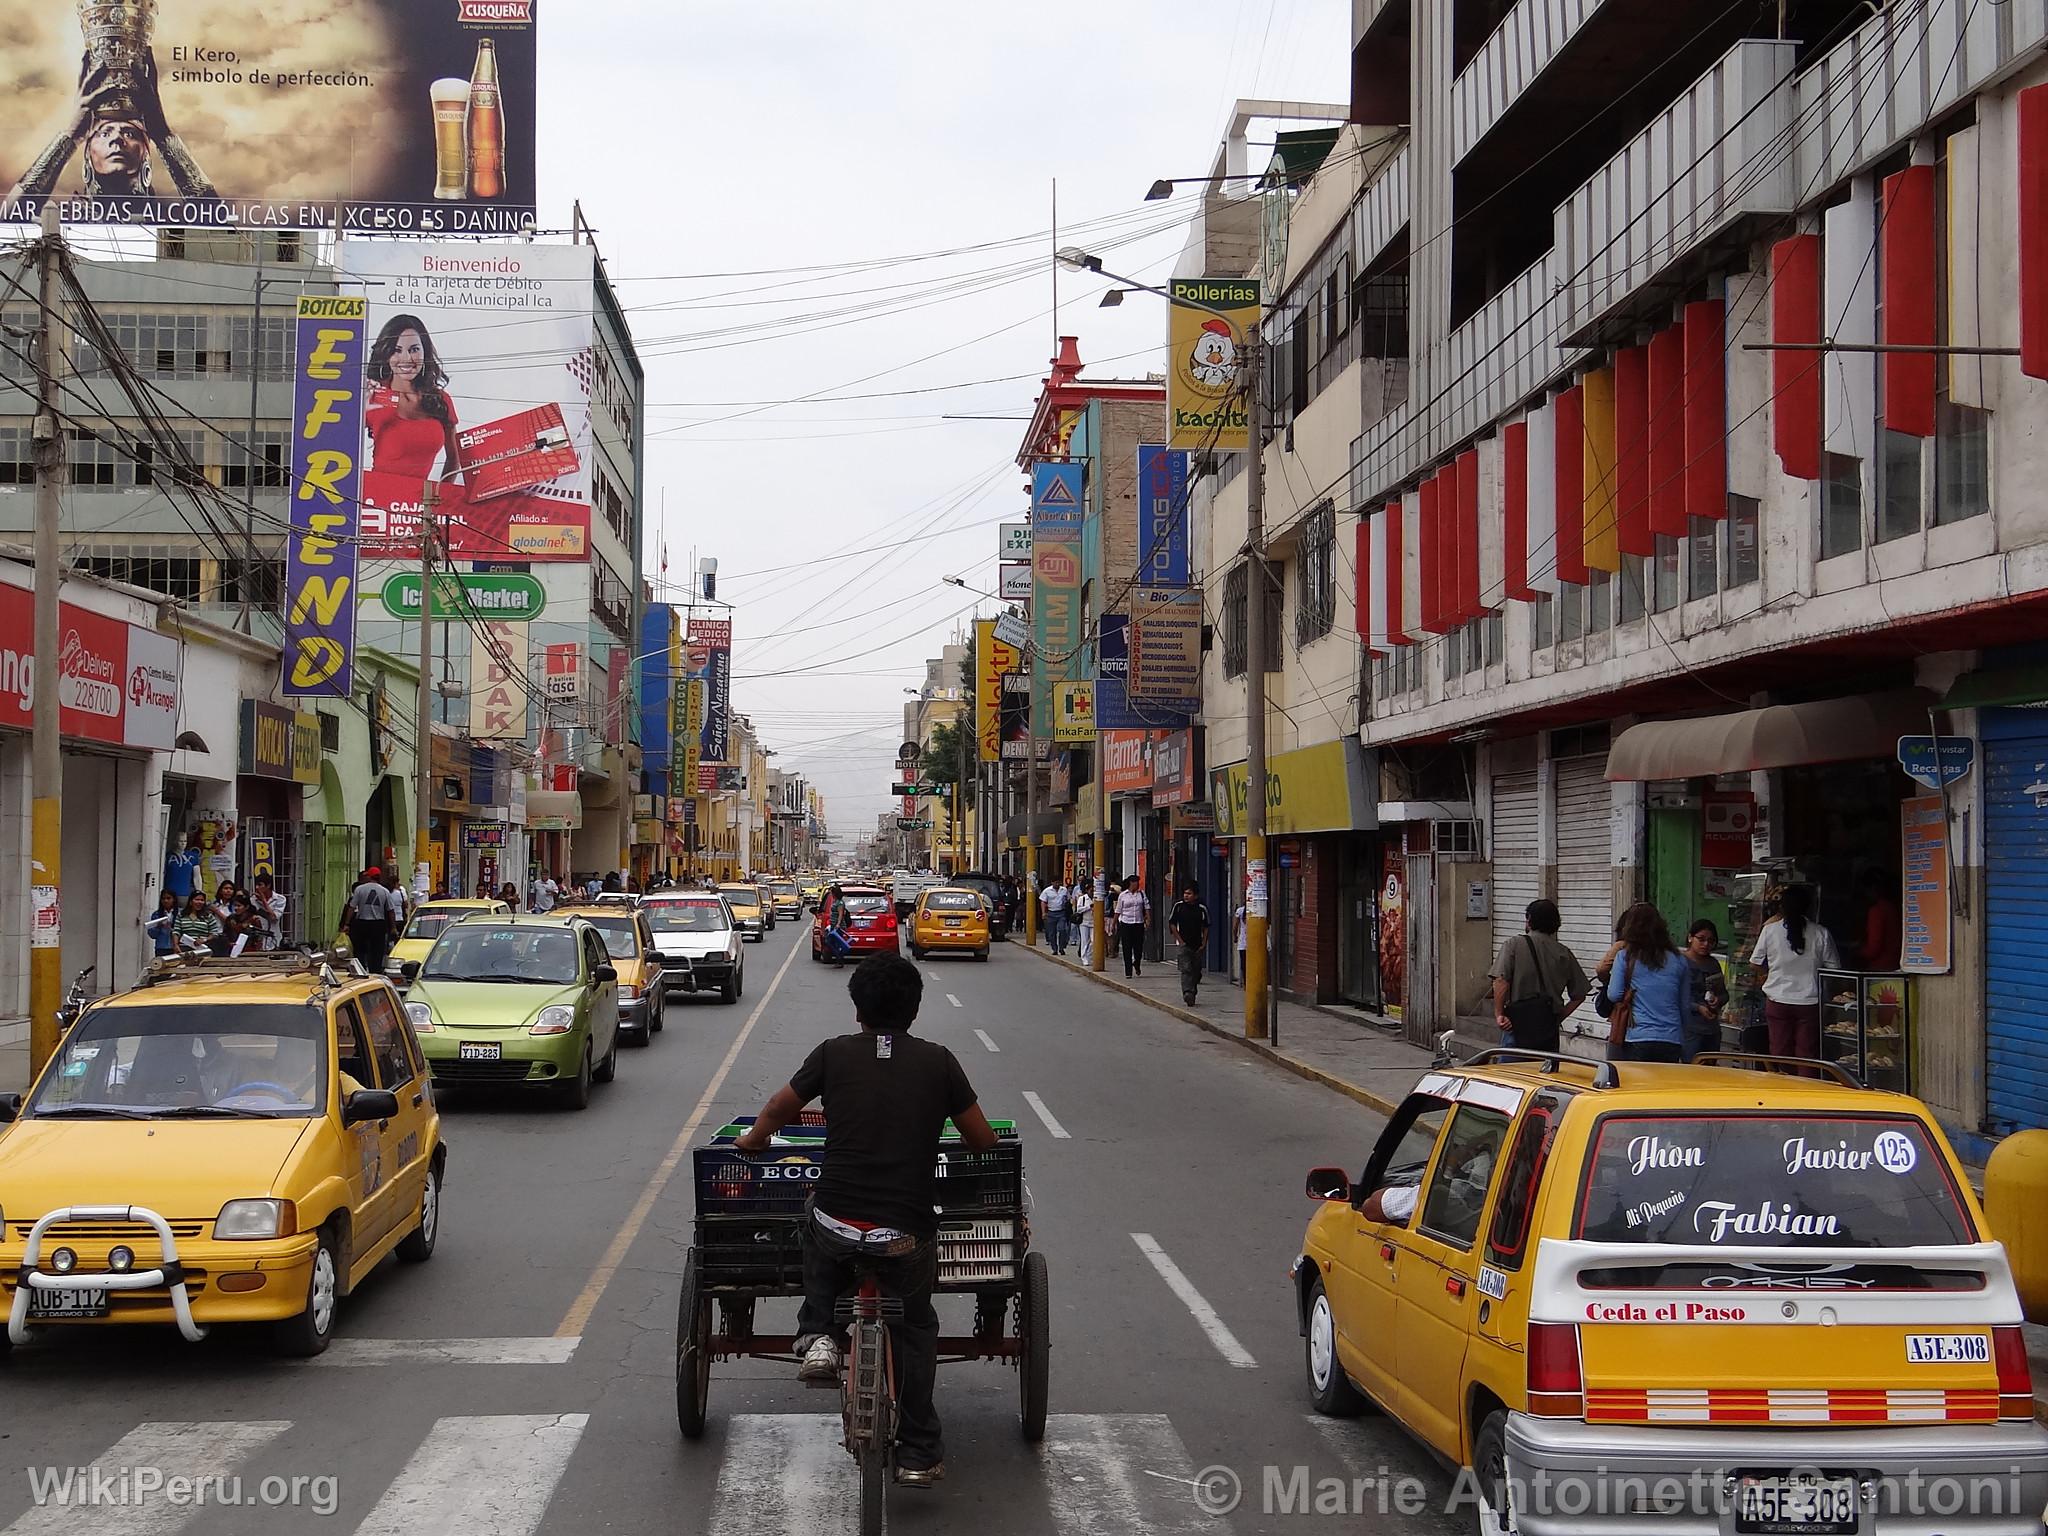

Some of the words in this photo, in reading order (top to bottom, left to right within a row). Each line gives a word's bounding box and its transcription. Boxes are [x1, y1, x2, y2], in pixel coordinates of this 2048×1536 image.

[466, 3, 525, 18] CUSQUEÑA
[172, 46, 188, 61] El
[195, 47, 241, 64] Kero,
[172, 68, 242, 84] símbolo
[249, 69, 270, 85] de
[277, 71, 374, 88] perfección.
[60, 201, 132, 222] EBIDAS
[142, 200, 289, 227] ALCOHÓLICAS
[300, 206, 324, 226] EN
[334, 207, 413, 229] XCESO
[453, 205, 535, 232] DAÑINO
[423, 255, 521, 273] Bienvenido
[396, 278, 403, 287] a
[408, 274, 419, 287] la
[424, 275, 470, 290] Tarjeta
[474, 276, 490, 290] de
[495, 276, 543, 291] Débito
[1175, 284, 1255, 301] Pollerías
[298, 298, 364, 317] BOTICAS
[388, 290, 407, 304] de
[410, 291, 421, 304] la
[425, 292, 455, 308] Caja
[459, 292, 529, 309] Municipal
[534, 293, 552, 307] Ica
[289, 328, 355, 688] EFREND
[390, 501, 425, 513] CAJA
[509, 513, 539, 524] Afiliado
[541, 516, 549, 524] a:
[390, 526, 415, 537] ICA
[1014, 530, 1031, 539] DI
[513, 537, 566, 551] globalnet
[469, 587, 530, 610] Market
[1150, 592, 1168, 602] Bio
[690, 620, 730, 630] CLINICA
[690, 629, 730, 638] MEDICO
[82, 650, 115, 680] Delivery
[1131, 623, 1141, 692] LABORATORIO
[0, 649, 34, 711] ng
[485, 621, 513, 730] KODAK
[547, 677, 576, 694] fasa
[710, 652, 725, 717] Nazareno
[74, 680, 112, 714] 228700
[676, 683, 687, 730] ODONTO
[690, 684, 698, 731] CLINICA
[709, 717, 724, 761] Señor
[1004, 741, 1047, 757] DENTES
[687, 748, 696, 795] DENTAL
[1911, 764, 1961, 776] Recagas
[905, 772, 913, 816] CON
[1232, 771, 1282, 812] kato
[1065, 851, 1073, 885] FOTO
[1389, 883, 1396, 896] 9
[1627, 1135, 1705, 1176] Jhon
[1782, 1137, 1874, 1175] Javier
[1877, 1137, 1914, 1168] 125
[761, 1166, 822, 1179] ECO
[1626, 1208, 1643, 1230] Mi
[1644, 1188, 1685, 1222] Pequeño
[1692, 1201, 1841, 1243] Fabian
[1585, 1303, 1647, 1322] Ceda
[1655, 1303, 1677, 1322] el
[1686, 1304, 1746, 1322] Paso
[1910, 1335, 1988, 1361] A5E-308
[1745, 1488, 1850, 1522] A5E-308
